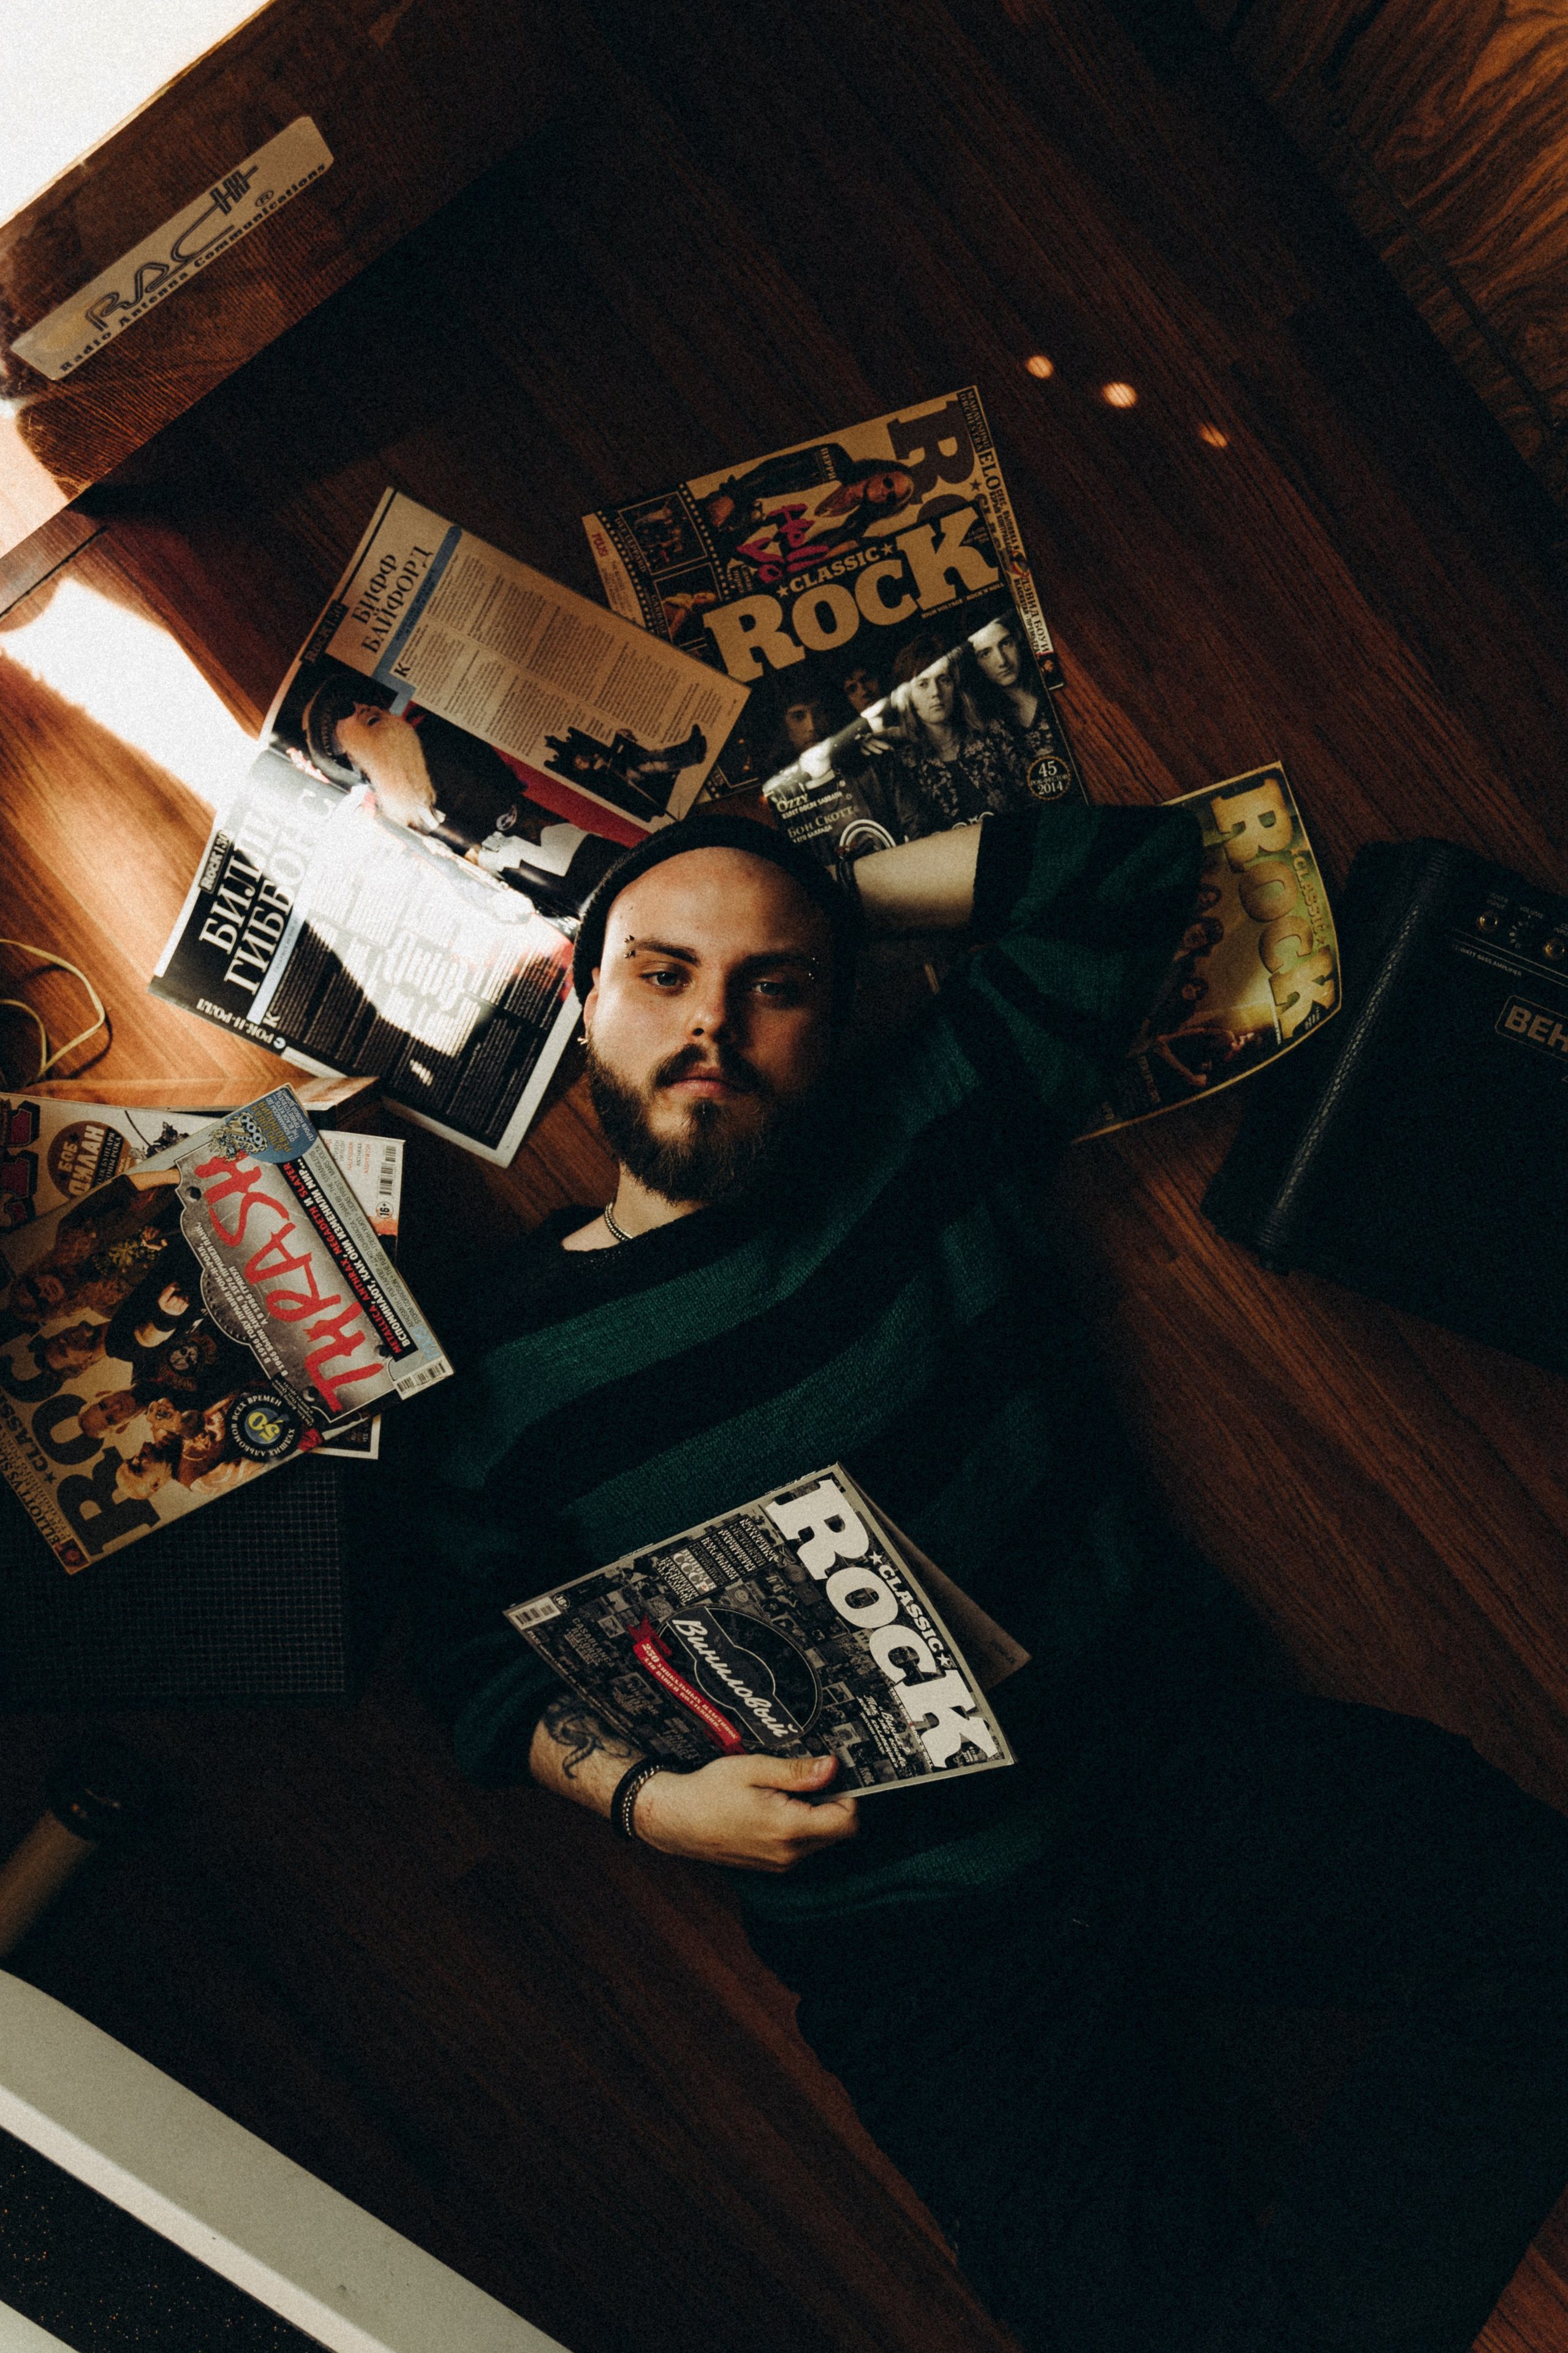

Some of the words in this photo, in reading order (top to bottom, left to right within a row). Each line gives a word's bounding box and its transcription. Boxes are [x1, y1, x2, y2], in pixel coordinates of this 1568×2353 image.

[59, 328, 113, 373] Radio
[118, 269, 189, 327] Antenna
[193, 161, 328, 269] Communications
[977, 450, 1001, 491] ELO
[623, 533, 648, 574] LEPPARD
[787, 544, 881, 595] CLASSIC
[350, 552, 401, 625] БИФФ
[361, 543, 434, 654] БАЙФОРД
[703, 506, 1004, 684] ROCK
[1019, 576, 1039, 618] ДЭВИД
[1033, 619, 1050, 652] БОУИ
[1037, 759, 1058, 778] 45
[1038, 780, 1063, 794] 2014
[787, 820, 814, 838] БОН
[813, 804, 854, 827] СКОТТ
[1208, 776, 1341, 1040] ROCK
[1290, 854, 1327, 934] CLASSIC
[1518, 906, 1543, 920] VOLUME
[1476, 954, 1492, 964] BASS
[1492, 960, 1522, 976] AMPLIFIER
[265, 1097, 274, 1105] ДО
[275, 1100, 286, 1114] KEYS
[250, 1104, 282, 1152] БЛЮЗОВАЯ
[257, 1100, 292, 1152] РЕВОЛЮЦИЯ
[270, 1104, 290, 1135] БОНАМАССЫ
[282, 1114, 294, 1130] BLACK
[291, 1128, 300, 1138] THE
[57, 1141, 78, 1172] БОБ
[67, 1124, 105, 1196] ДИЛАН
[111, 1136, 121, 1157] РОКА
[314, 1142, 328, 1160] VOLTA
[282, 1160, 309, 1196] SLAYER
[309, 1149, 331, 1182] STRANGLERS
[324, 1158, 337, 1175] MARS
[335, 1177, 349, 1196] PRIEST
[312, 1185, 348, 1239] ИЗМЕНИЛИ
[338, 1200, 352, 1217] SHAM
[345, 1195, 358, 1212] JUDAS
[376, 1201, 392, 1218] 16+
[194, 1220, 212, 1244] ПАНК,
[308, 1203, 344, 1254] MEGADETH
[349, 1218, 371, 1250] БОНАМАССА
[365, 1230, 379, 1248] ГЛЕНН
[342, 1237, 360, 1259] ОНИ
[195, 1242, 229, 1291] РОК-Н-РОЛЛ,
[195, 1150, 382, 1410] THRASH
[229, 1264, 250, 1293] ГРЯНУЛ
[338, 1252, 372, 1301] ANTHRAX,
[354, 1257, 373, 1279] КАК
[375, 1265, 391, 1286] ХАРПЕР
[225, 1274, 241, 1294] 1976
[391, 1276, 413, 1308] CORROSION
[224, 1290, 246, 1320] ПРАВИЛ
[240, 1299, 261, 1328] ХИППИ,
[245, 1292, 261, 1312] 1986
[366, 1278, 412, 1346] ВСПОМИНАЮТ,
[395, 1298, 415, 1328] AEROSMITH
[408, 1306, 422, 1323] STORM
[241, 1318, 257, 1339] ГОДУ
[256, 1327, 275, 1351] БЫЛИ
[366, 1299, 403, 1353] METALLICA,
[251, 1337, 268, 1357] 1956
[270, 1350, 285, 1369] 1966
[230, 1401, 247, 1422] ВСЕХ
[245, 1394, 282, 1407] ВРЕМЕН
[229, 1424, 265, 1459] АЛЬБОМОВ
[6, 1470, 25, 1491] VS
[18, 1487, 61, 1545] ELLIOTT
[671, 1551, 710, 1594] СССР
[875, 1560, 944, 1655] CLASSIC
[766, 1480, 998, 1768] ROCK
[570, 1626, 602, 1664] RECORDS
[571, 1616, 615, 1669] CASABLANCA
[640, 1641, 661, 1664] 250
[656, 1662, 702, 1704] УНИКАЛЬНЫХ
[701, 1703, 738, 1740] ПЛАСТИНОК
[671, 1618, 802, 1740] Виниловый
[890, 1687, 901, 1705] TRUE
[863, 1692, 881, 1716] Так
[877, 1716, 890, 1735] это
[887, 1736, 908, 1767] основа
